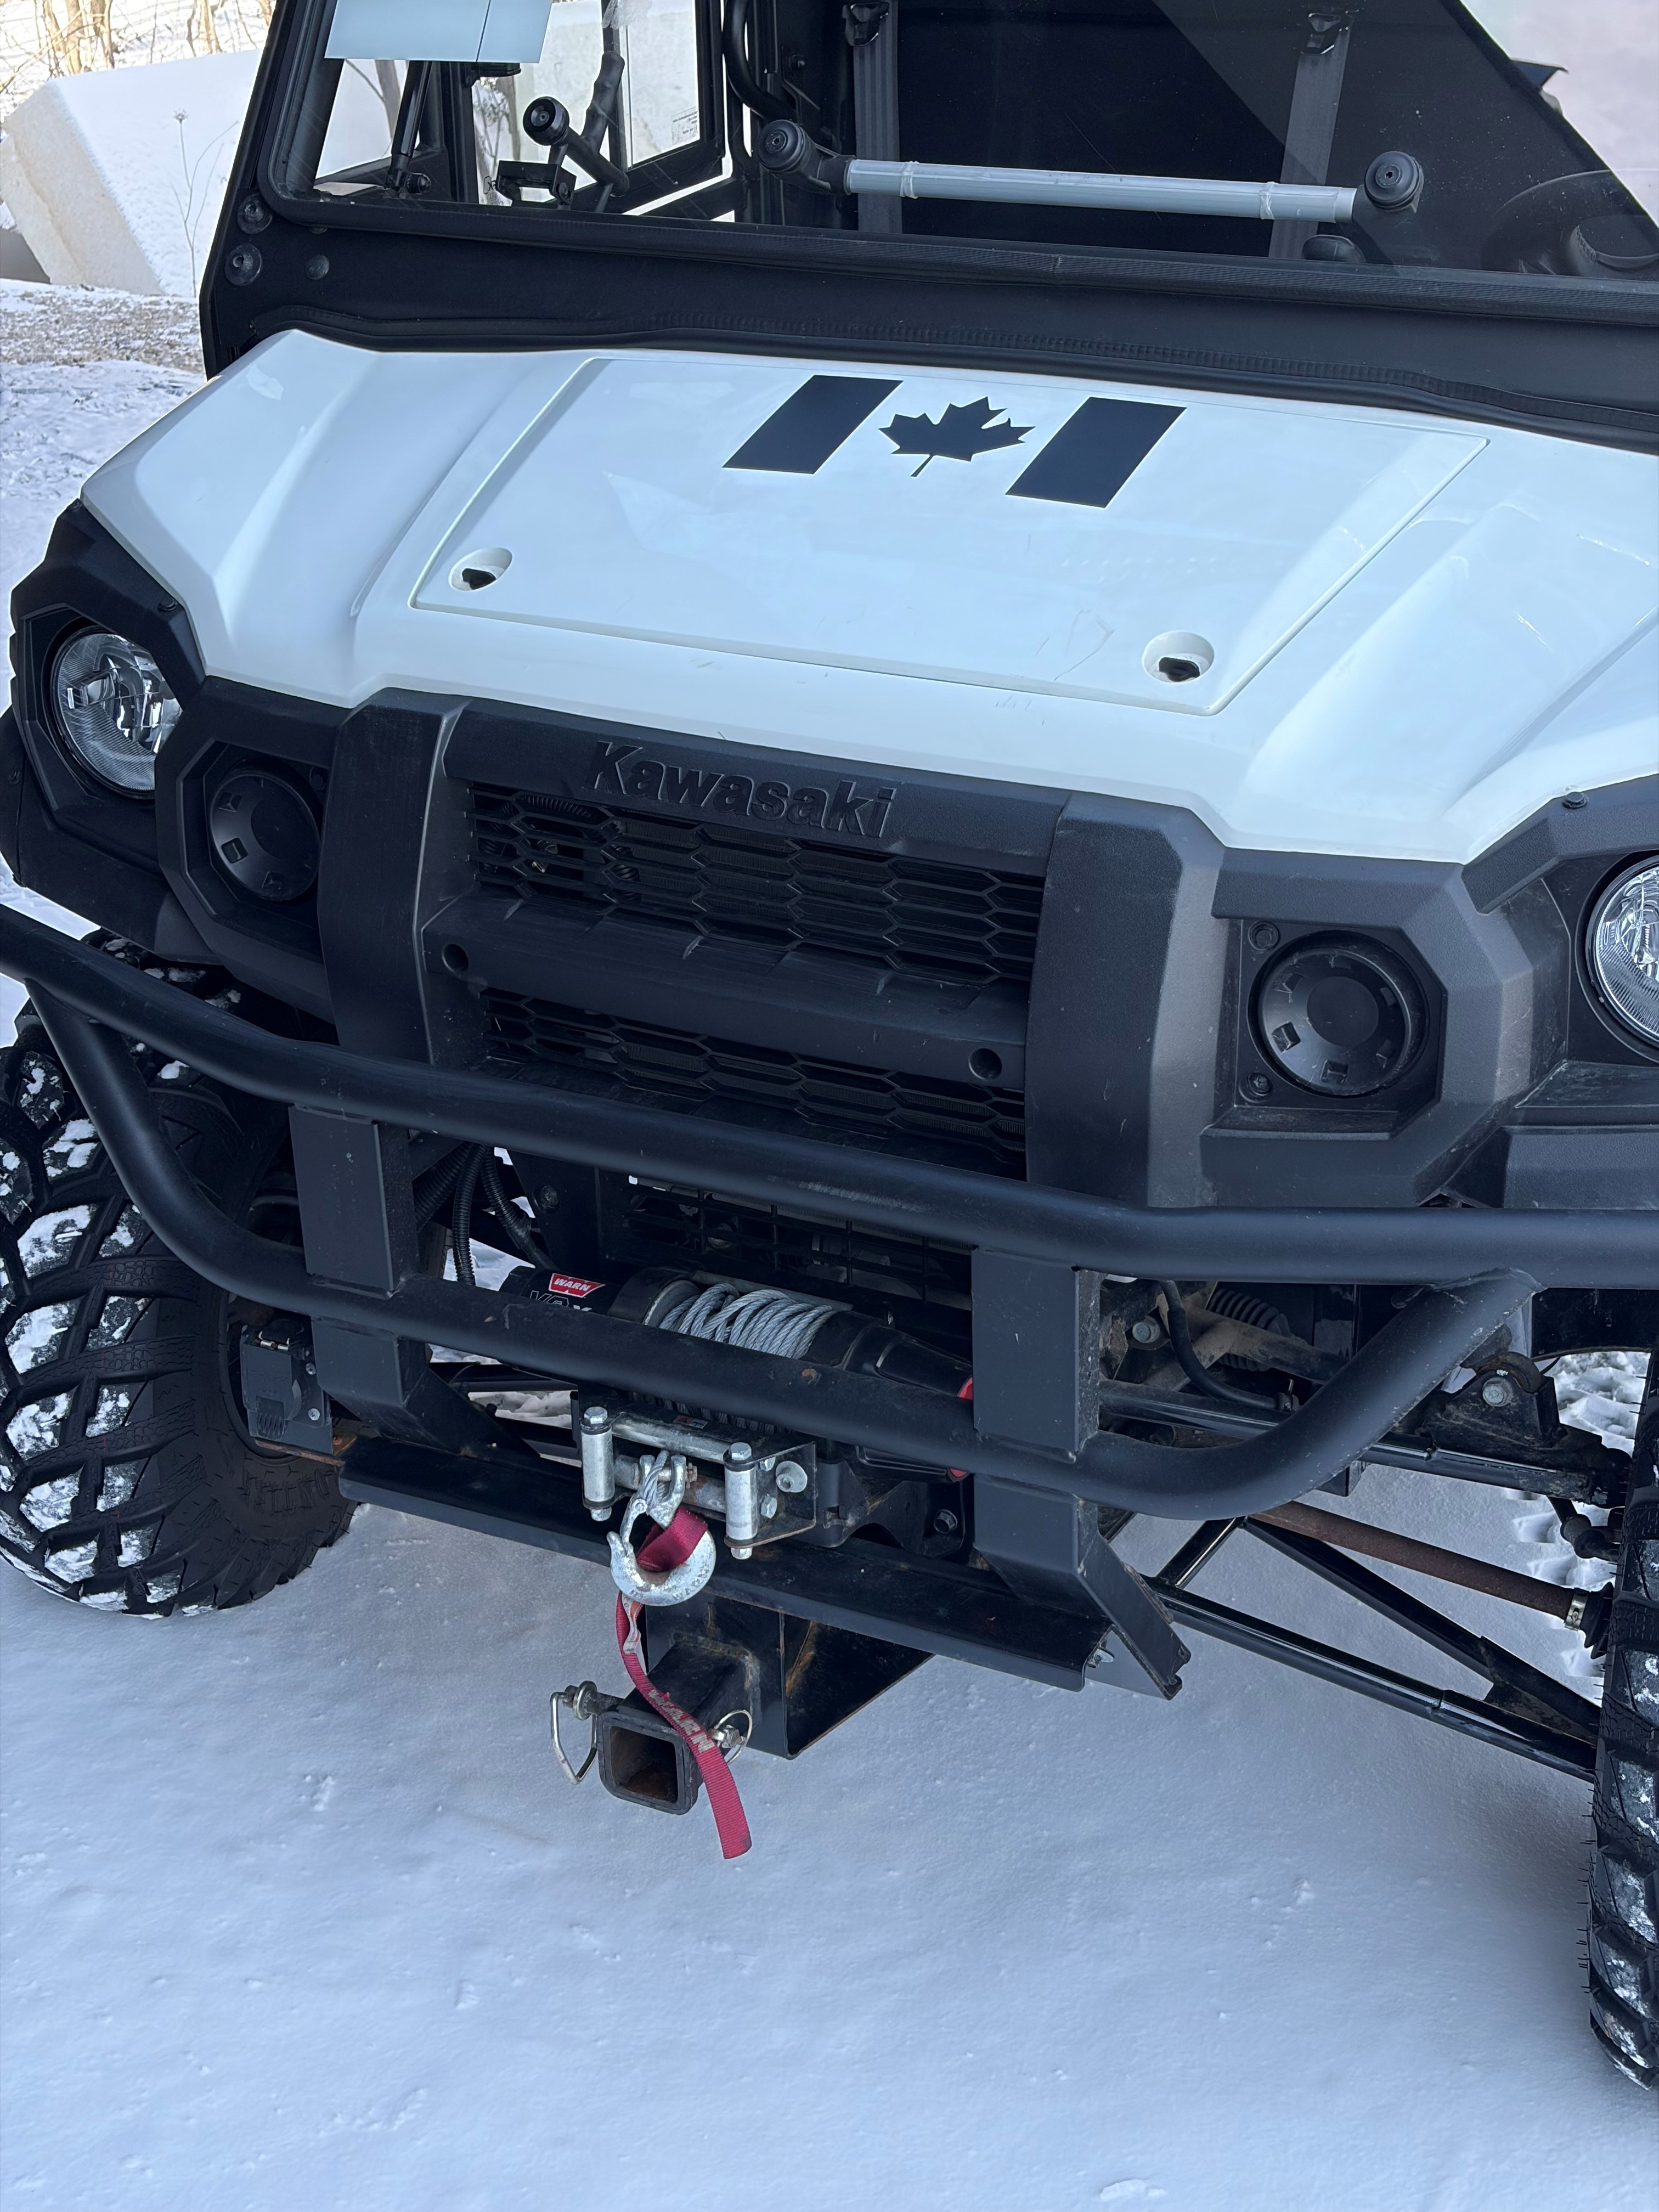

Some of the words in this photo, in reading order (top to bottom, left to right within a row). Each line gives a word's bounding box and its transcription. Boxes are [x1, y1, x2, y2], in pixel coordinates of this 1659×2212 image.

[582, 741, 897, 838] Kawasaki
[554, 1278, 591, 1291] WARN
[648, 1689, 714, 1753] WARN
